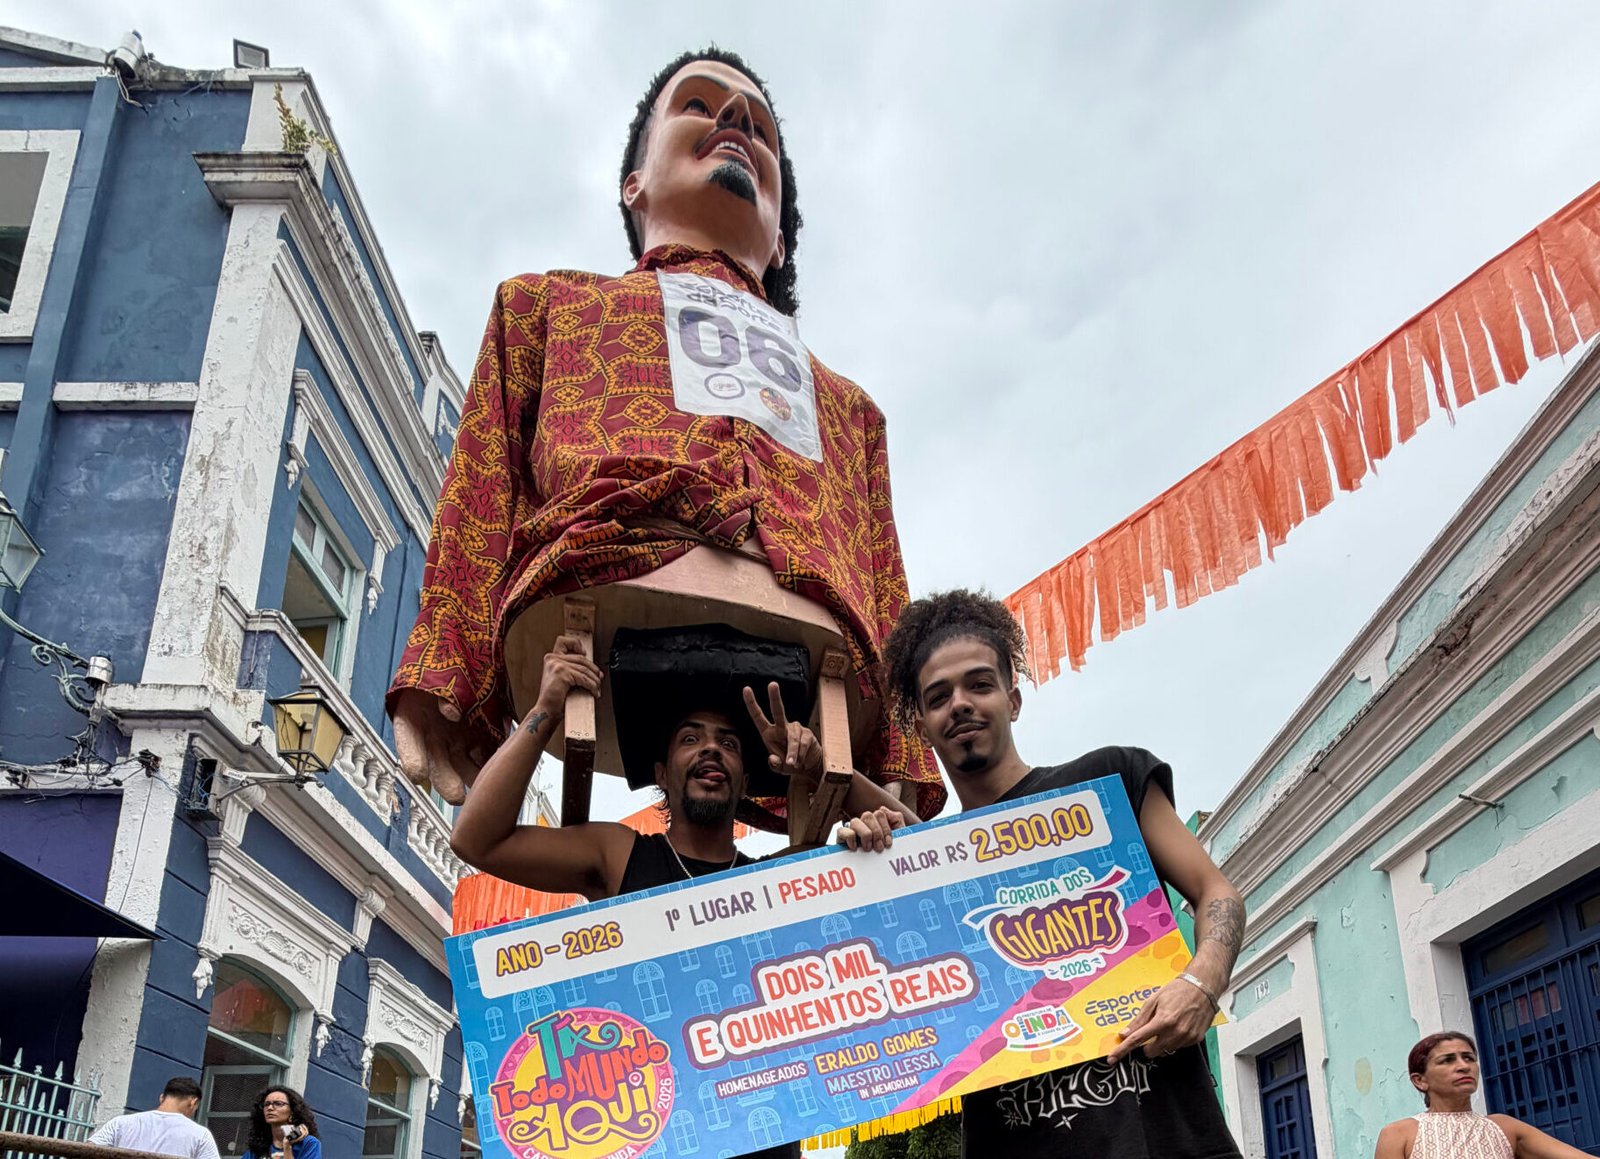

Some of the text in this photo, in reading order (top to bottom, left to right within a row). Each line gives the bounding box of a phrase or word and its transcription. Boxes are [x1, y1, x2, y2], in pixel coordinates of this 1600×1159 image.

[679, 306, 802, 392] 06
[889, 803, 1093, 877] VALOR R$ 2.500,00
[689, 891, 757, 926] LUGAR
[778, 867, 856, 904] PESADO
[999, 869, 1092, 905] CORRIDA DOS
[496, 941, 543, 977] ANO
[562, 921, 623, 959] 2026
[995, 897, 1117, 960] GIGANTES
[764, 950, 880, 1001] DOIS MIL
[1060, 959, 1092, 979] 2026
[1255, 979, 1270, 1001] 199
[696, 964, 967, 1057] E QUINHENTOS REAIS
[1005, 1009, 1071, 1040] OLINDA
[718, 1027, 938, 1096] HOMENAGEADOS ERALDO GOMES
[826, 1052, 941, 1094] MAESTRO LESSA
[859, 1075, 918, 1099] IN MEMORIAM
[657, 1077, 672, 1110] 2026
